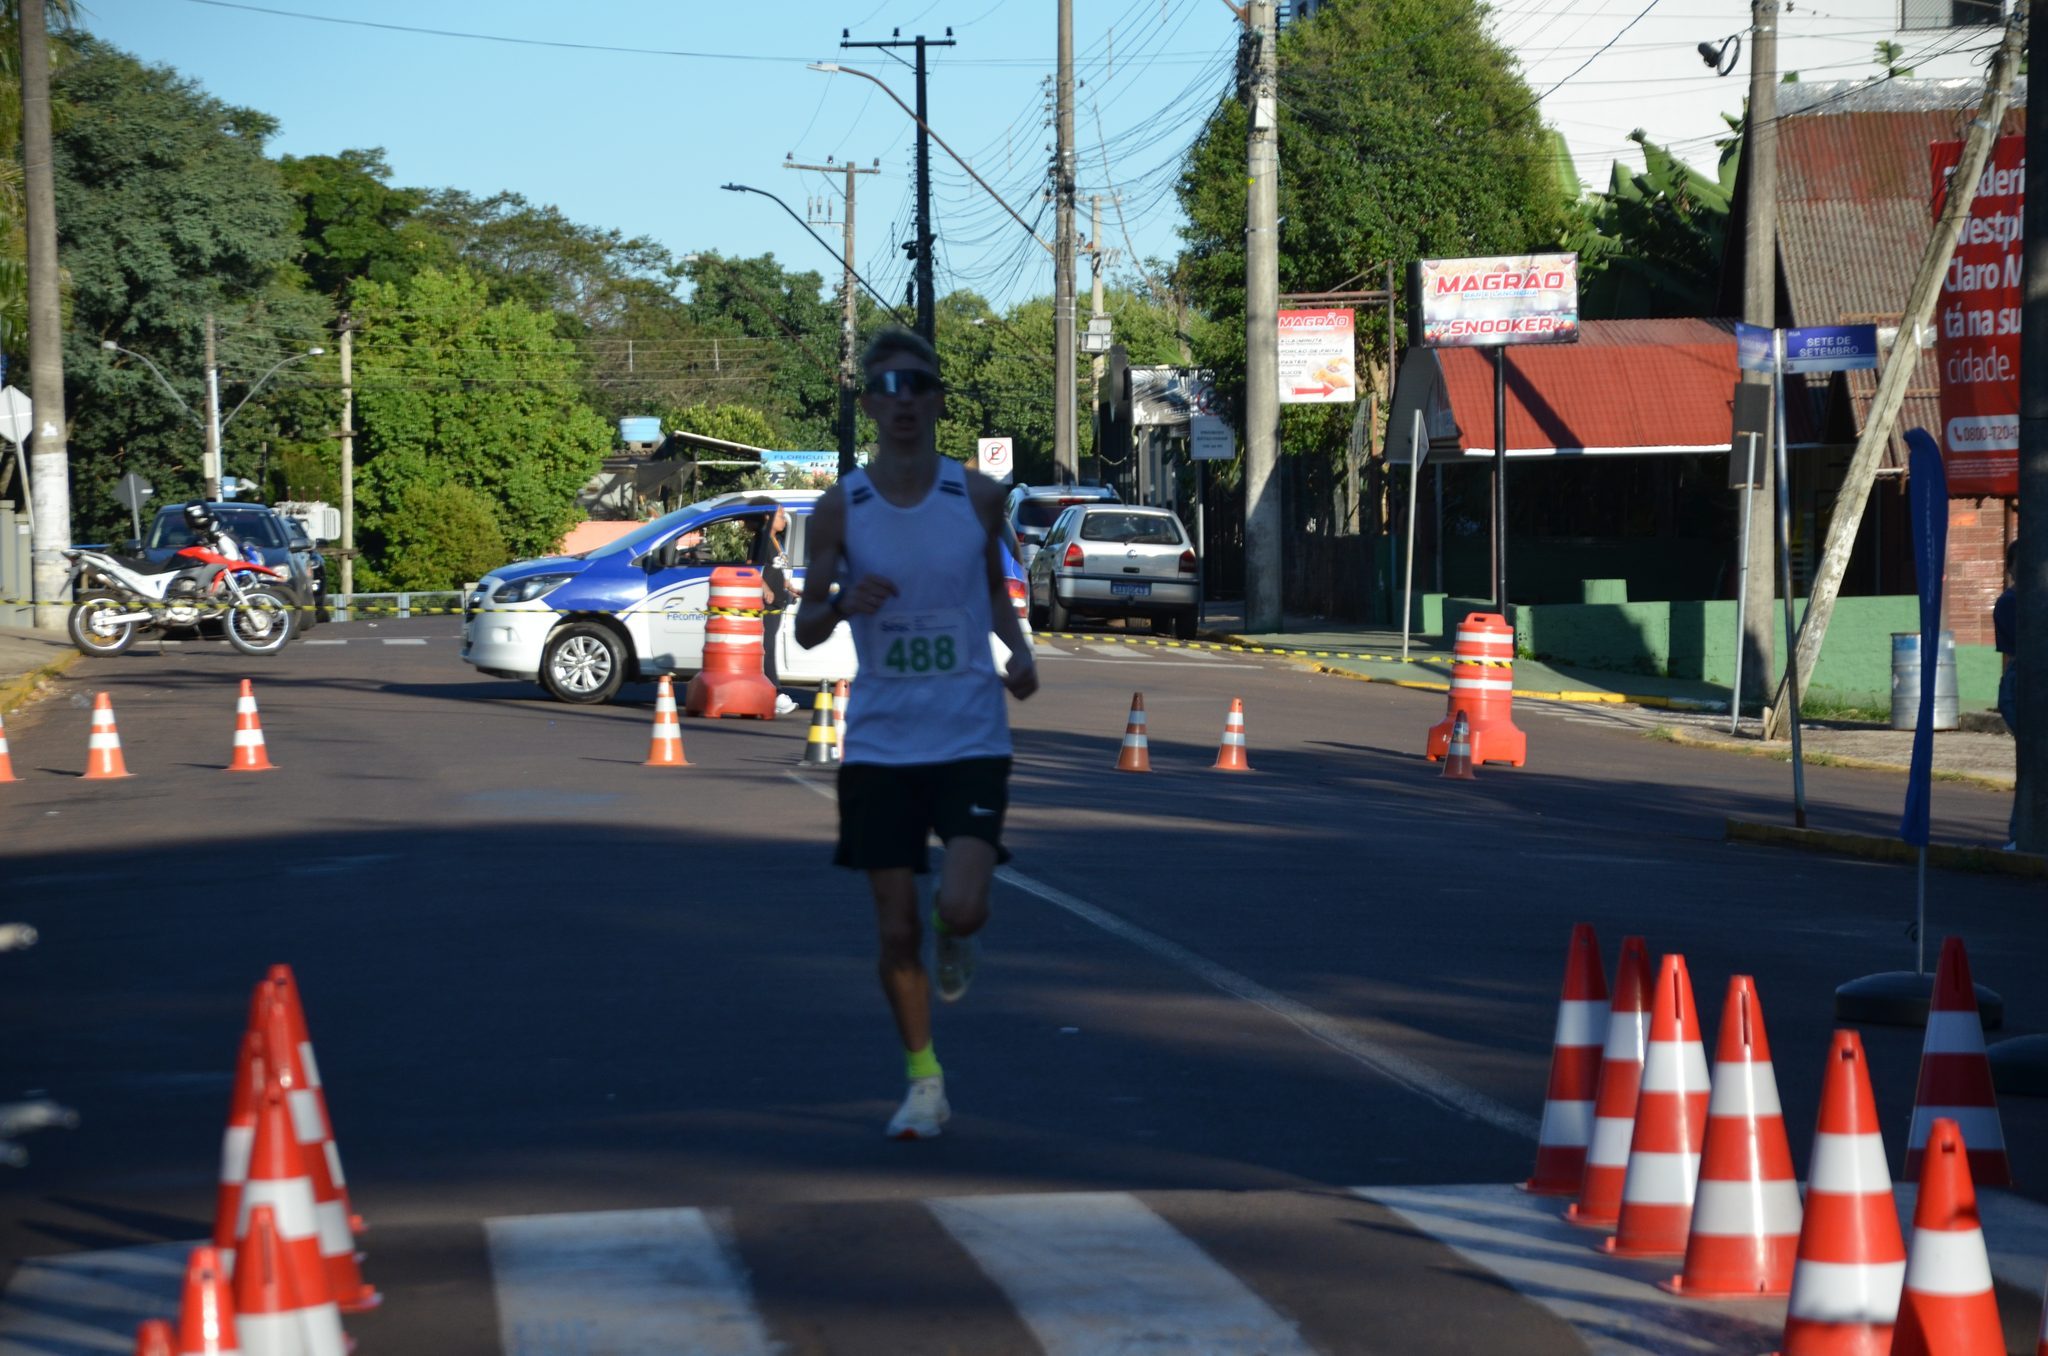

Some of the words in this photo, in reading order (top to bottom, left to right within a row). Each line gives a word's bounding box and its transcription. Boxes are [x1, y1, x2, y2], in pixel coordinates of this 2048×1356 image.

[1436, 266, 1565, 294] MAGRÃO
[1944, 256, 2000, 293] Claro
[1278, 312, 1349, 328] MAGRÃO
[1450, 317, 1553, 335] SNOOKER
[1944, 301, 1965, 338] tá
[1967, 308, 1995, 337] na
[1799, 345, 1860, 358] SETEMBRO
[1806, 337, 1834, 348] SETE
[1836, 336, 1852, 346] DE
[1947, 345, 2016, 384] cidade.
[885, 633, 957, 673] 488
